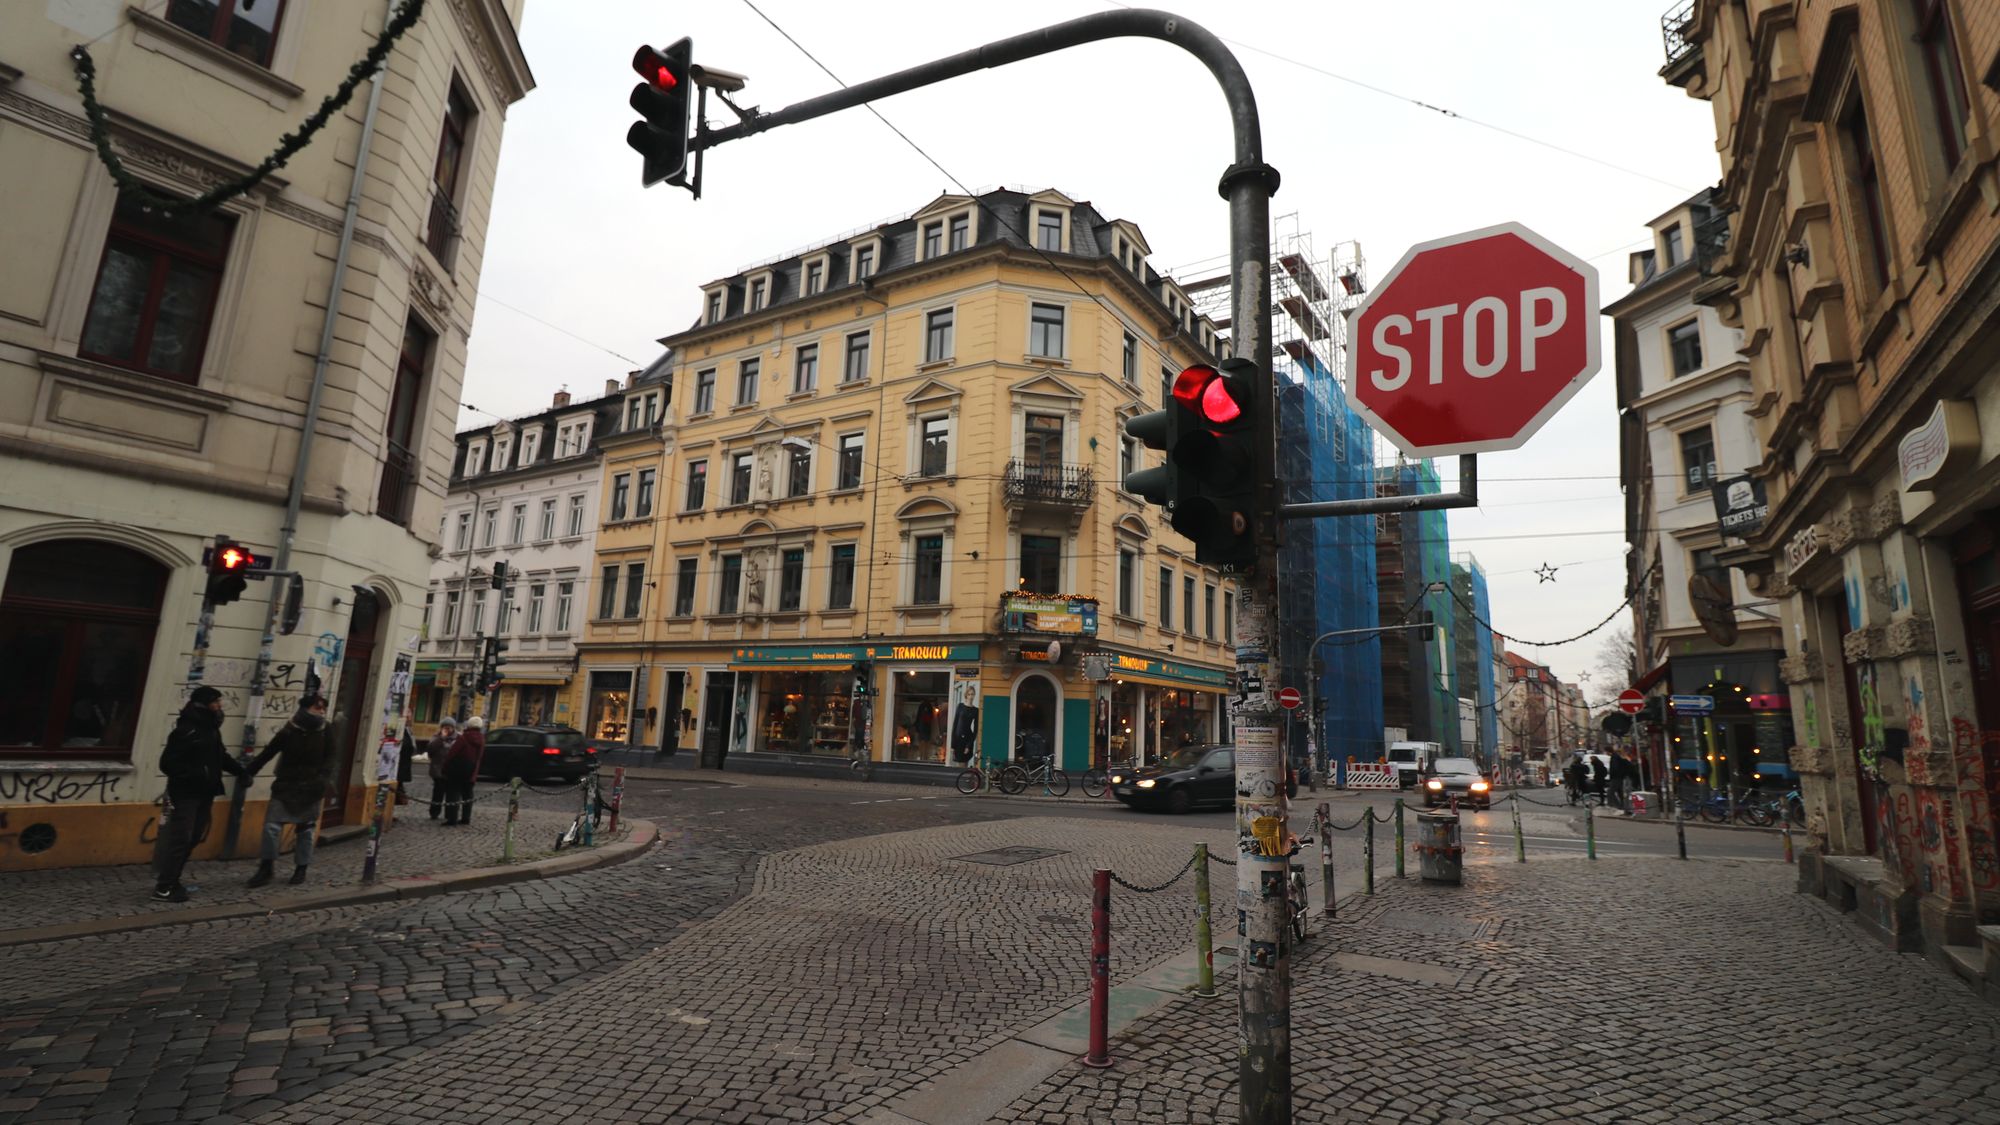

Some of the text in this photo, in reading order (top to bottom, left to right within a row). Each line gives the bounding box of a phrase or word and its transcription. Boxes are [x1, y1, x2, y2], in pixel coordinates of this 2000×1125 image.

[1370, 286, 1568, 392] STOP
[1721, 509, 1753, 527] TICKETS
[1223, 563, 1234, 573] K1
[892, 646, 949, 660] TRANQUILLO
